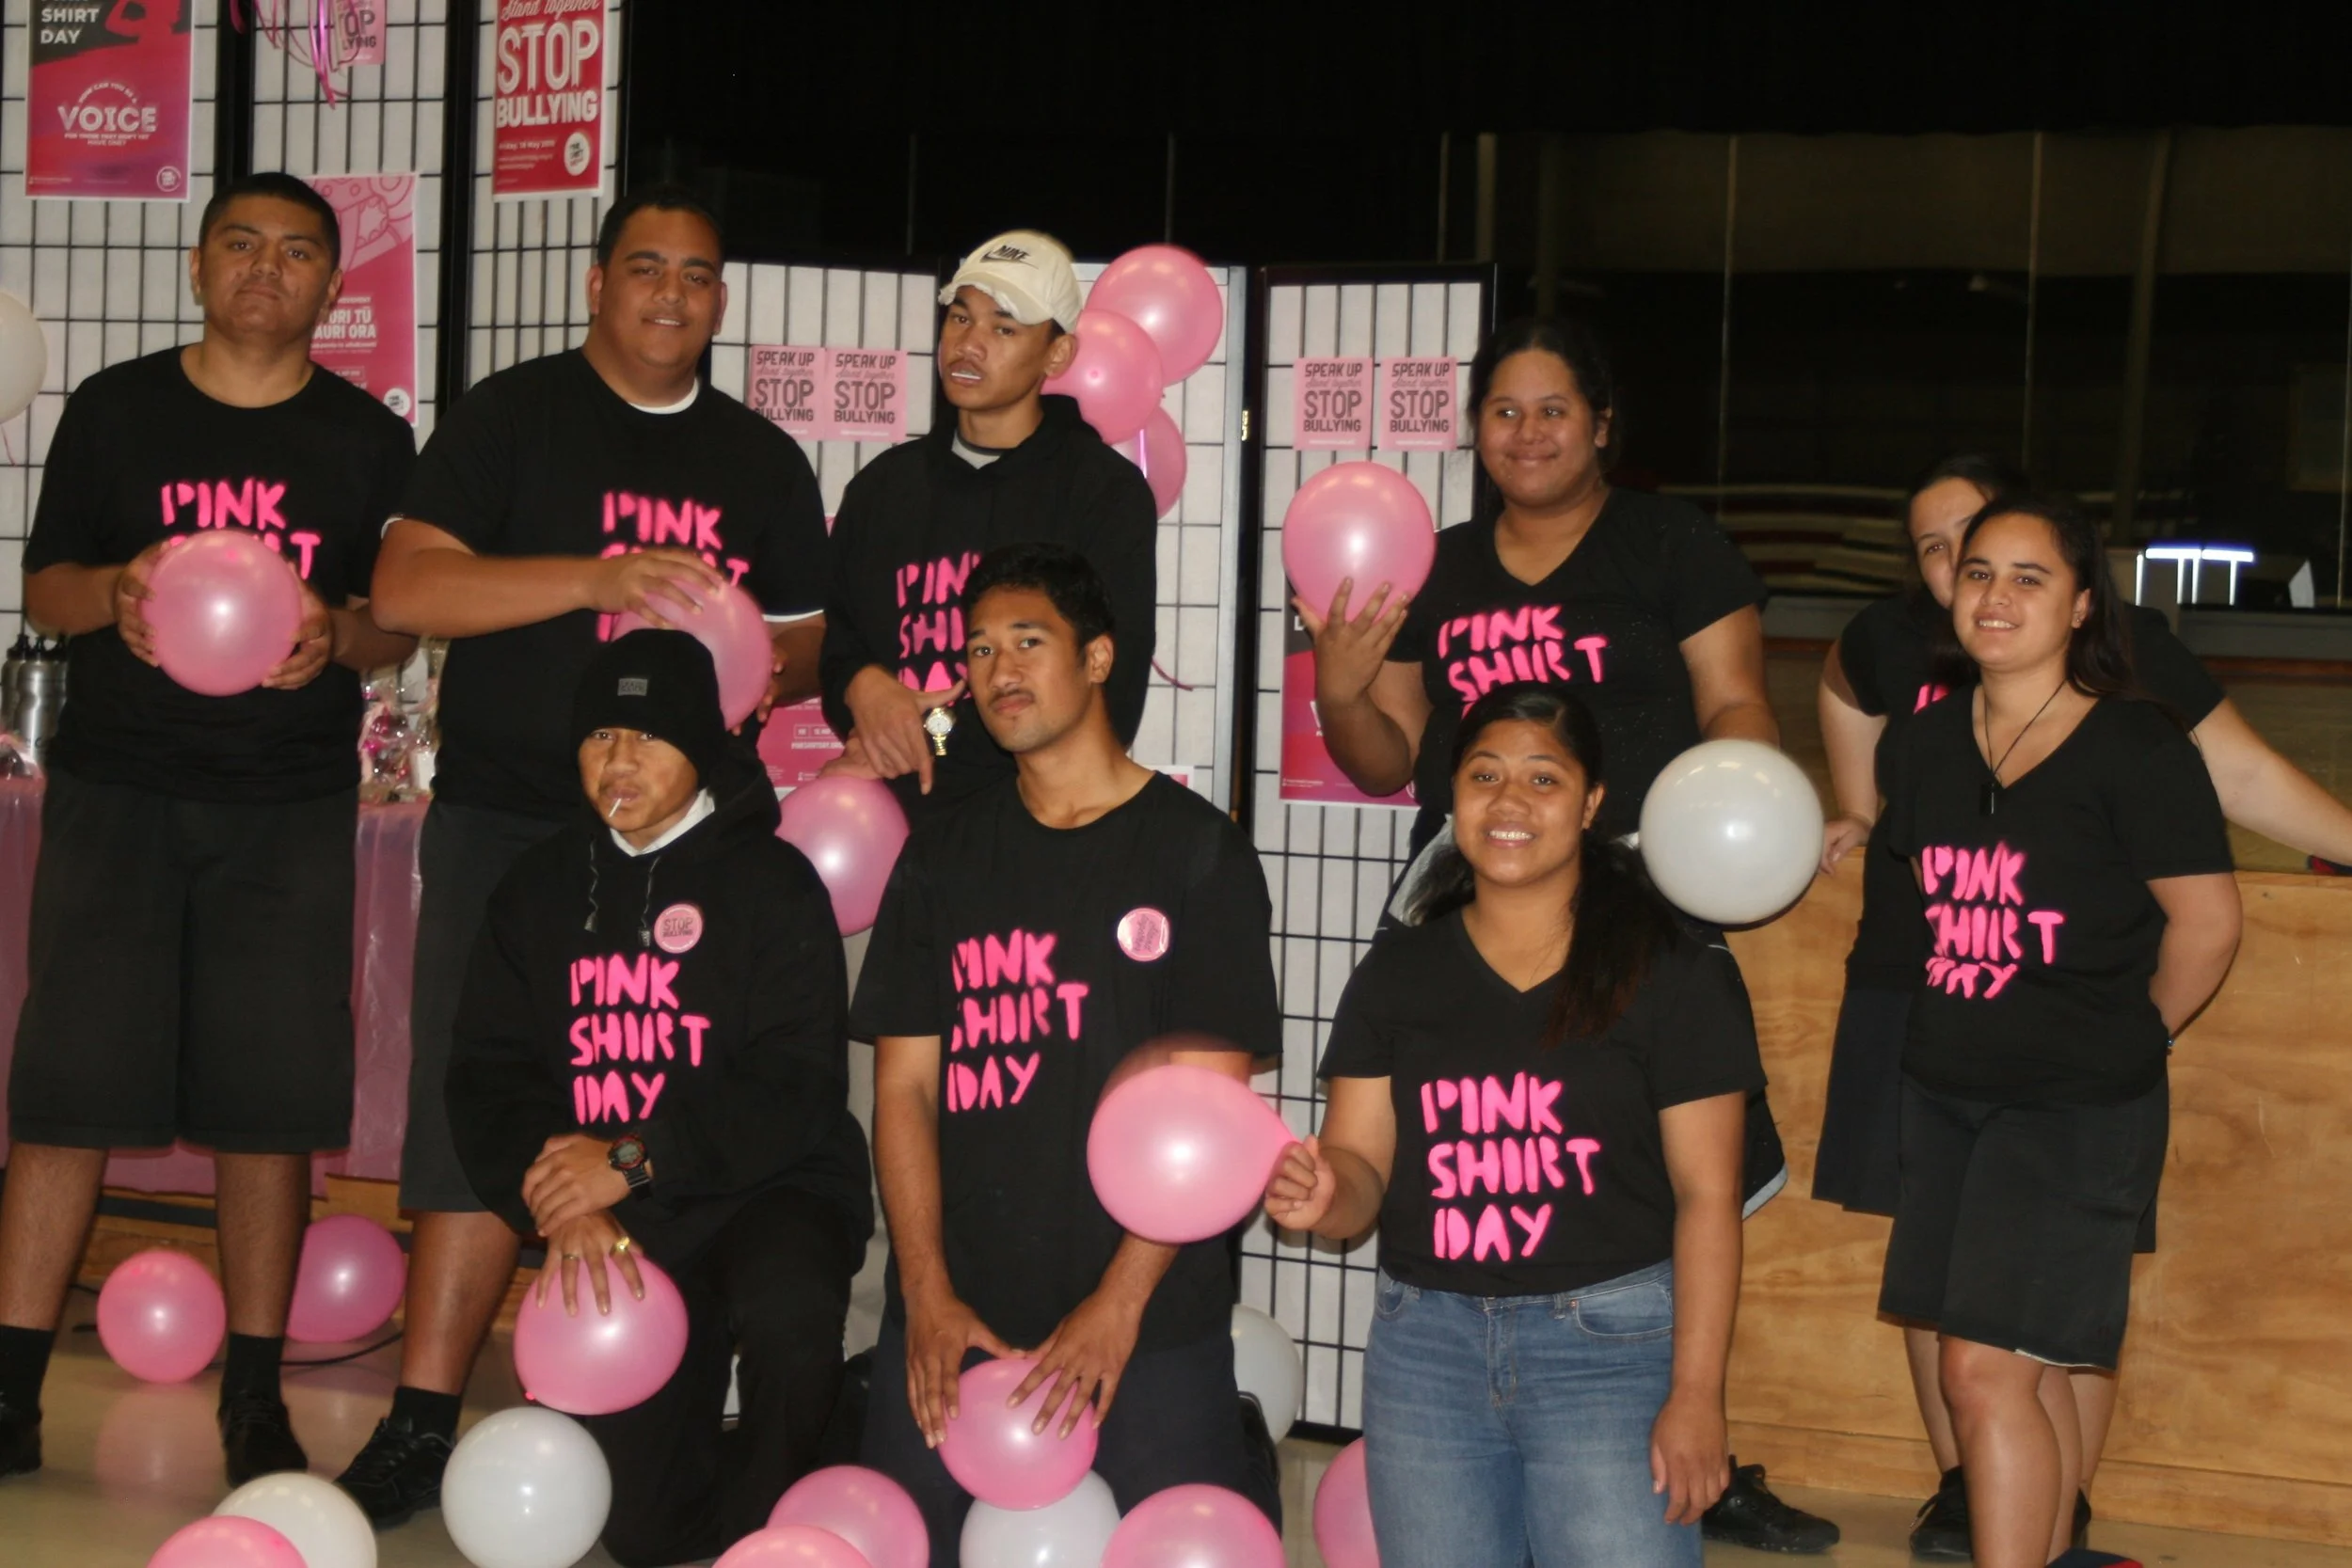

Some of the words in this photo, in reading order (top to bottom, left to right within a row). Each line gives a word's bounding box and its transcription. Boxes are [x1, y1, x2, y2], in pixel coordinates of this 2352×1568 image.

[40, 8, 99, 23] SHIRT
[40, 30, 81, 44] DAY
[498, 19, 599, 94] STOP
[57, 105, 157, 133] VOICE
[496, 90, 597, 128] BULLYING
[993, 245, 1029, 260] NIKE
[314, 324, 346, 339] AURI
[756, 351, 796, 365] SPEAK
[798, 352, 815, 366] UP
[835, 354, 876, 368] SPEAK
[879, 356, 896, 369] UP
[1305, 363, 1343, 377] SPEAK
[1346, 363, 1362, 377] UP
[1391, 363, 1432, 377] SPEAK
[1434, 363, 1450, 377] UP
[755, 378, 815, 407] STOP
[834, 380, 897, 410] STOP
[1304, 389, 1362, 420] STOP
[1390, 389, 1450, 420] STOP
[834, 410, 896, 424] BULLYING
[1303, 420, 1361, 433] BULLYING
[1390, 420, 1450, 434] BULLYING
[161, 478, 287, 531] PINK
[603, 492, 723, 550] PINK
[897, 552, 980, 609] PIN
[898, 607, 965, 658] SHI
[1438, 605, 1565, 659] PINK
[1448, 636, 1608, 702] SHIRT
[1922, 841, 2025, 906] PINK
[663, 918, 693, 930] STOP
[570, 952, 680, 1009] PINK
[569, 1011, 711, 1067] SHIRT
[573, 1070, 666, 1124] DAY
[946, 1052, 1041, 1113] DAY
[1421, 1070, 1564, 1134] PINK
[1427, 1135, 1601, 1200] SHIRT
[1433, 1203, 1553, 1262] DAY
